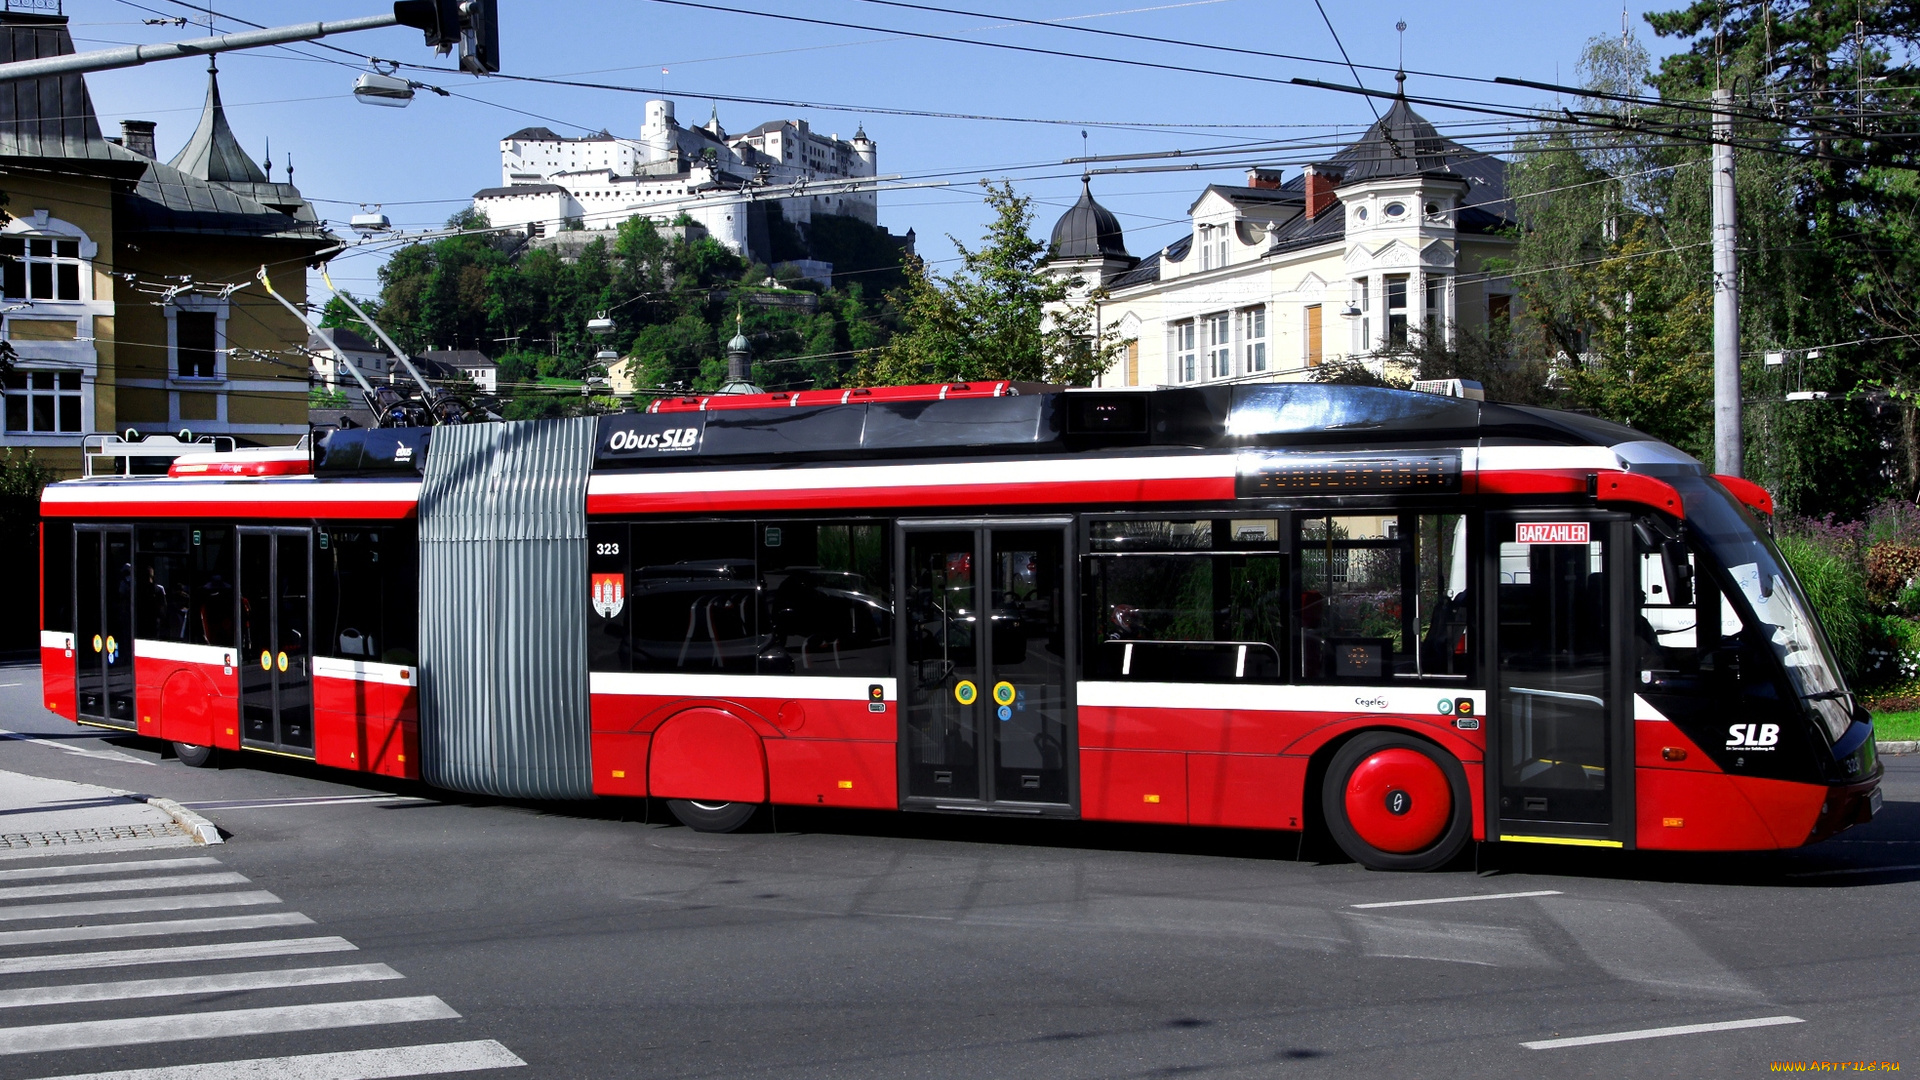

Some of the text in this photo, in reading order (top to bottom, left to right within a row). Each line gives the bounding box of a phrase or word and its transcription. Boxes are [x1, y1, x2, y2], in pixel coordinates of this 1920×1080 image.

[1520, 525, 1586, 541] BARZAHLER
[596, 543, 620, 555] 323
[1355, 697, 1386, 708] Cegelec
[1726, 723, 1780, 746] SLB
